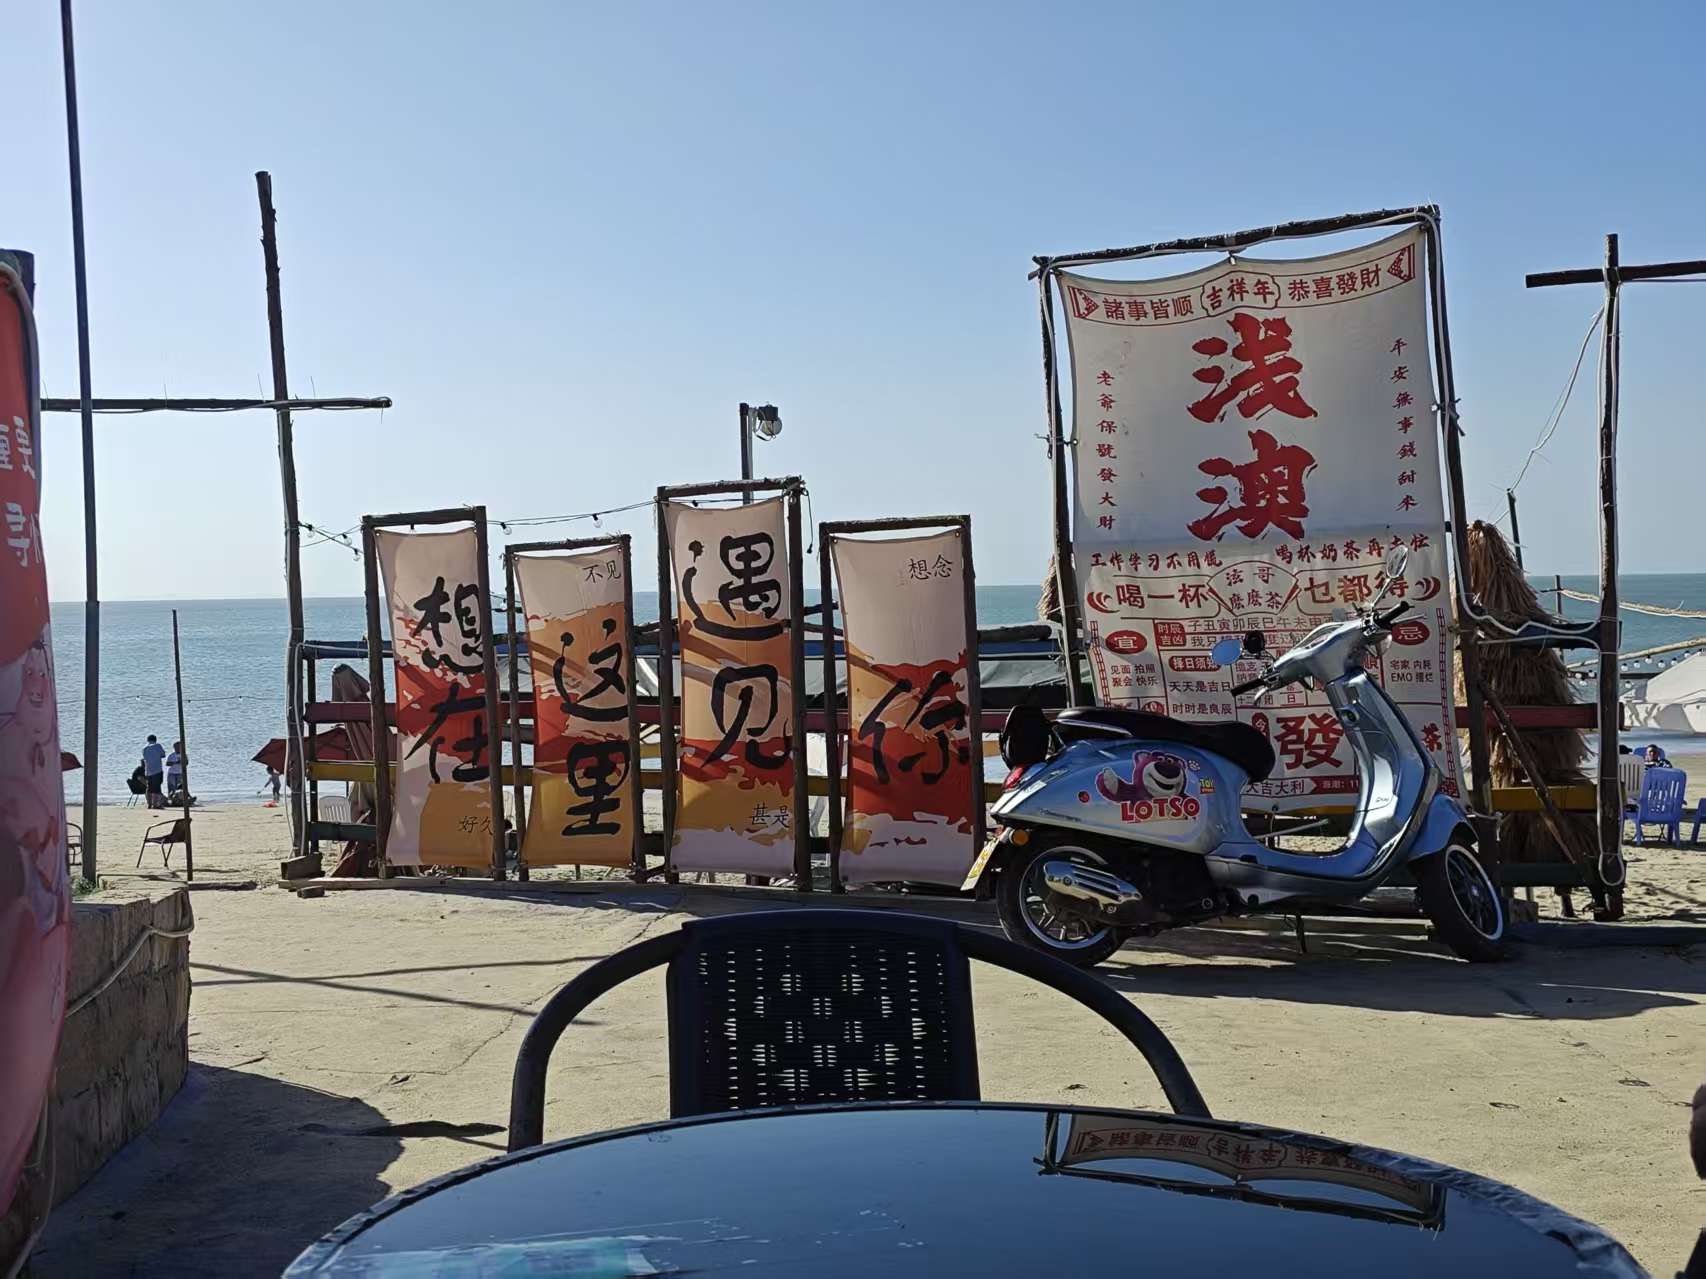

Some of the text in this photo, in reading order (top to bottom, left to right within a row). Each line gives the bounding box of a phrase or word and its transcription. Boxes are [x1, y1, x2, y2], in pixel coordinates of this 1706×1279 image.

[1207, 277, 1275, 311] 吉祥年
[1288, 264, 1381, 302] 恭喜發財
[582, 560, 621, 583] 不见
[908, 554, 953, 580] 想念
[1091, 549, 1222, 571] 工作学习不用慌
[1115, 583, 1208, 608] 喝一杯
[1114, 636, 1137, 649] 宜
[1398, 627, 1423, 640] 忌
[682, 532, 792, 769] 遇见
[404, 576, 490, 784] 想在
[1111, 663, 1156, 675] 见面 拍照
[1390, 672, 1413, 682] EMO
[1112, 676, 1158, 687] 聚会 快乐
[1170, 681, 1230, 692] 天天是吉日
[1172, 703, 1232, 715] 时时是良辰
[553, 618, 630, 836] 这里
[858, 671, 969, 784] 你
[1273, 713, 1344, 770] 發
[1246, 780, 1304, 795] 大吉大利
[749, 802, 790, 828] 甚是
[1120, 796, 1200, 823] LOTSO
[458, 815, 495, 836] 好久
